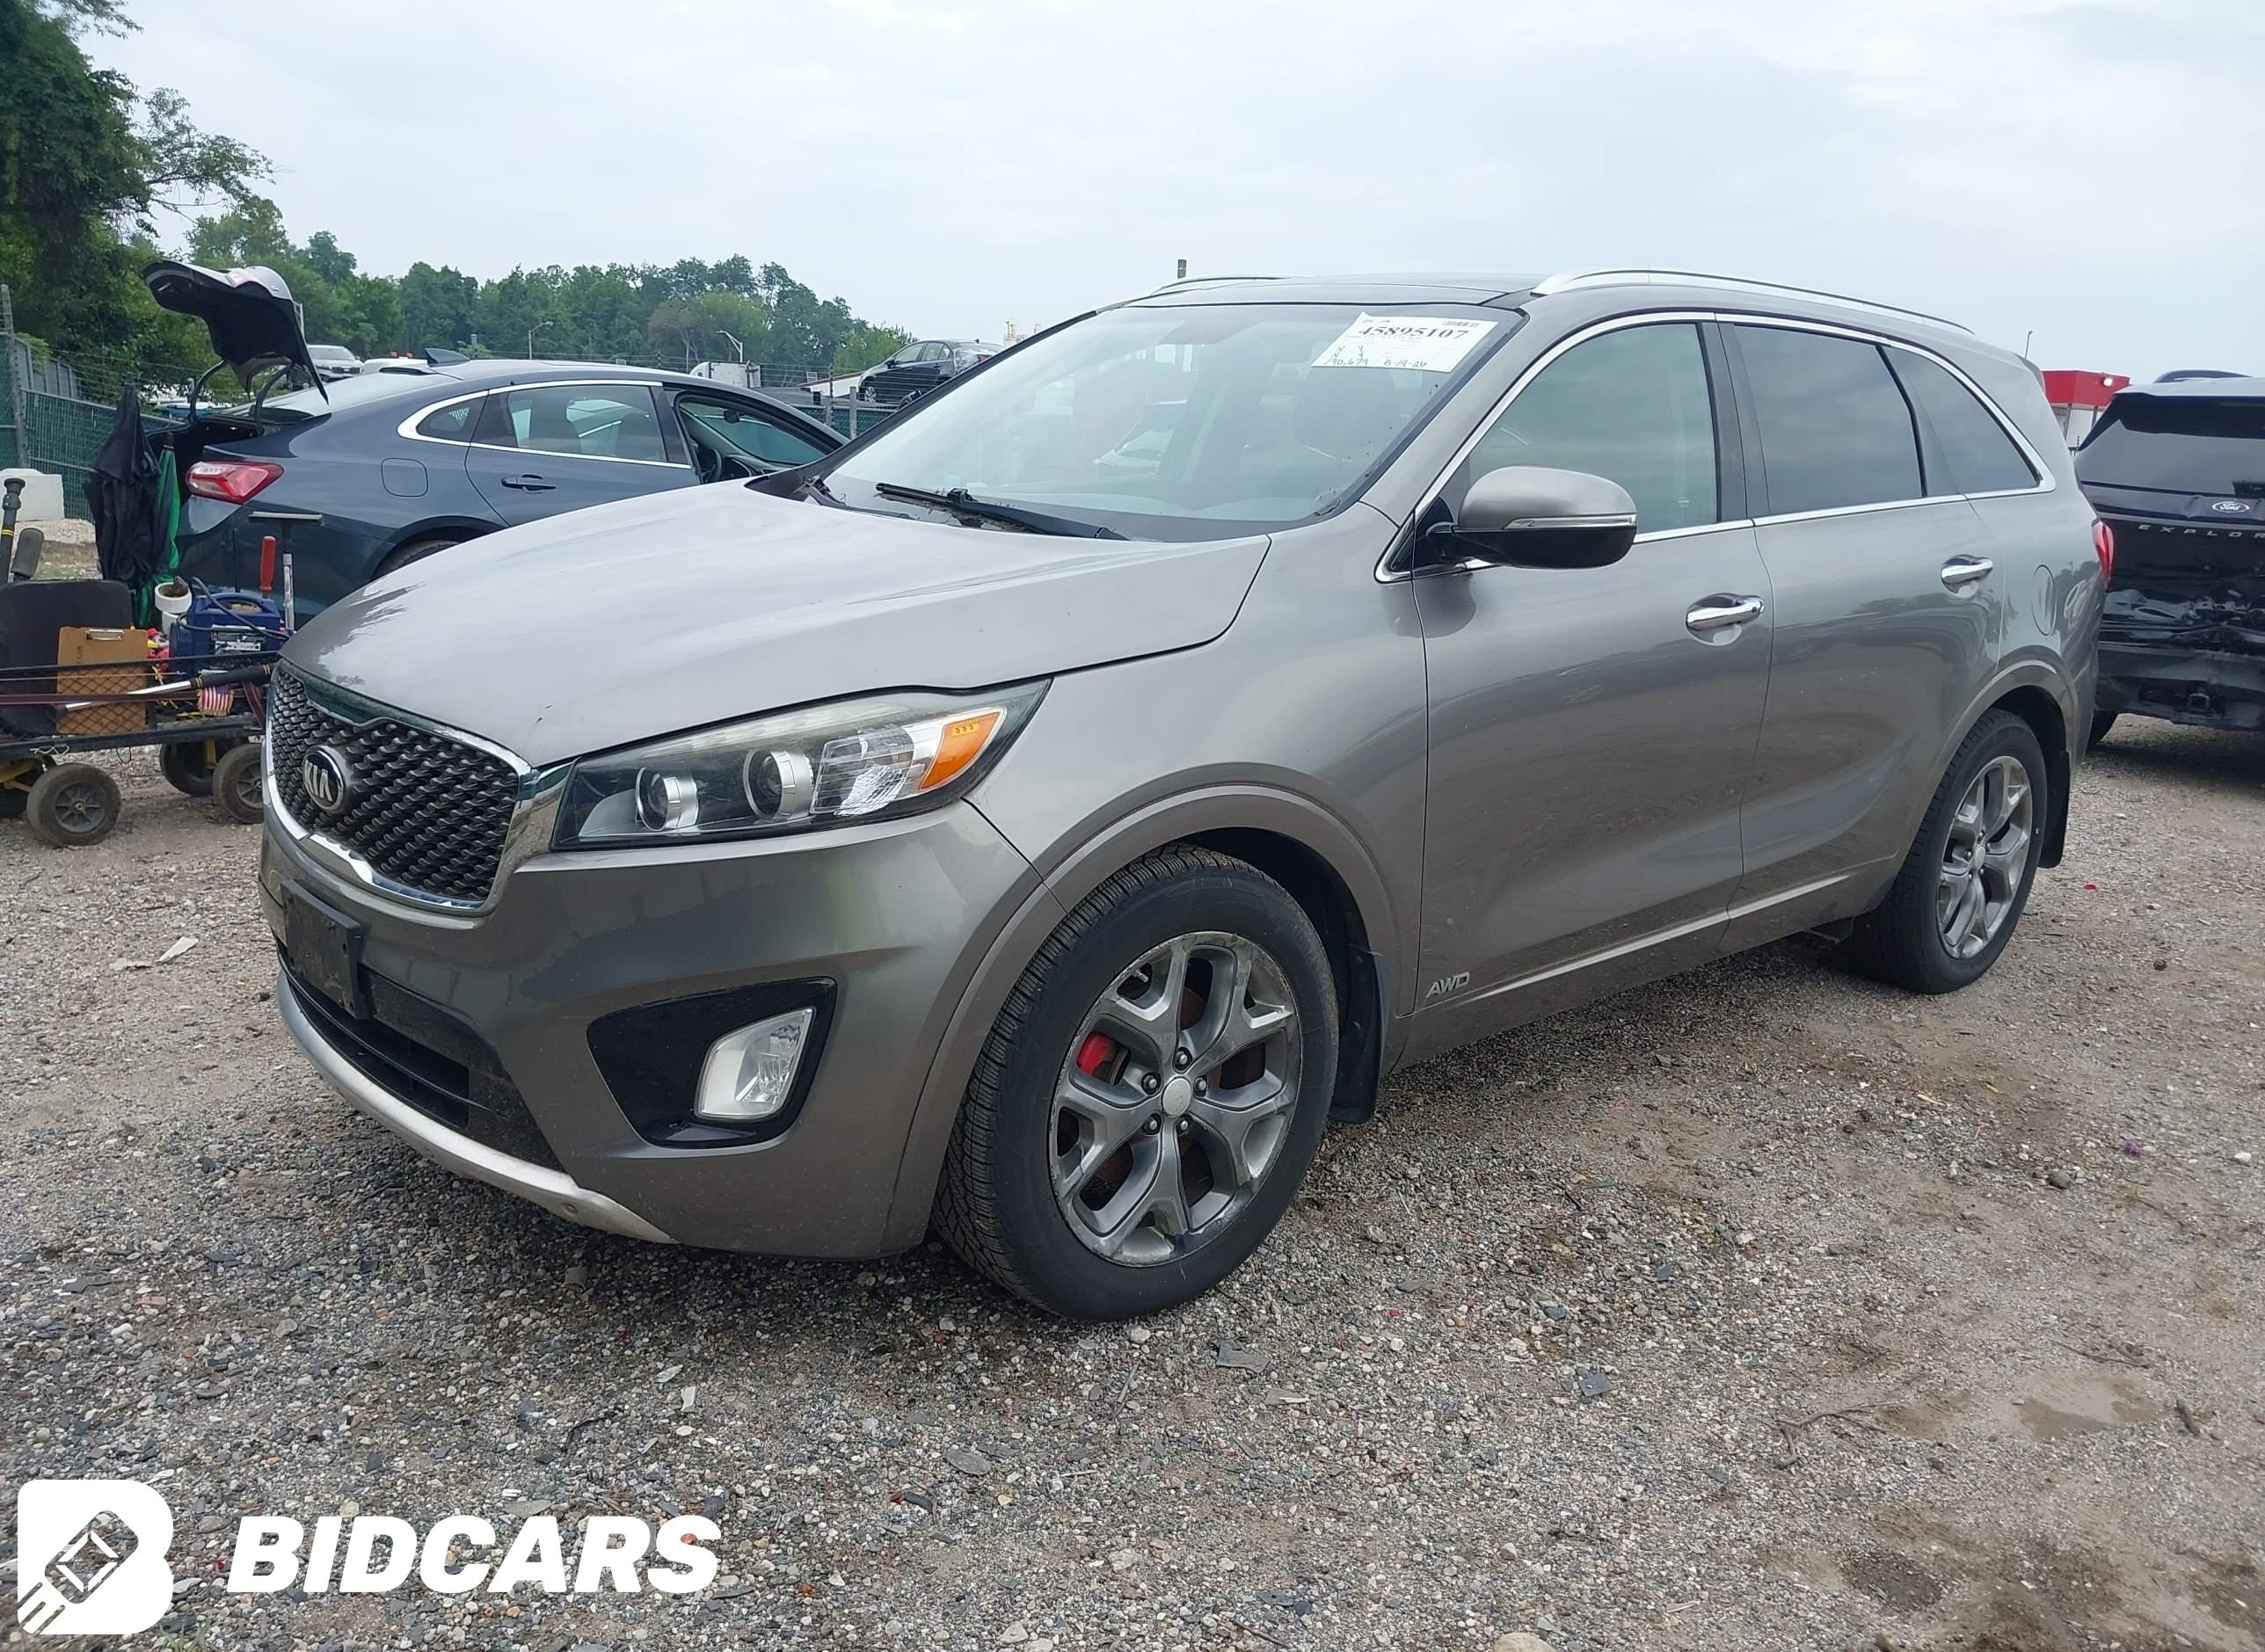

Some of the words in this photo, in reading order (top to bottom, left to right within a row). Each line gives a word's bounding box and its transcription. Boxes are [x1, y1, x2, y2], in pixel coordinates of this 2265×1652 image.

[1358, 324, 1471, 339] 45895107
[304, 760, 333, 802] KIA
[1425, 971, 1470, 998] AWD
